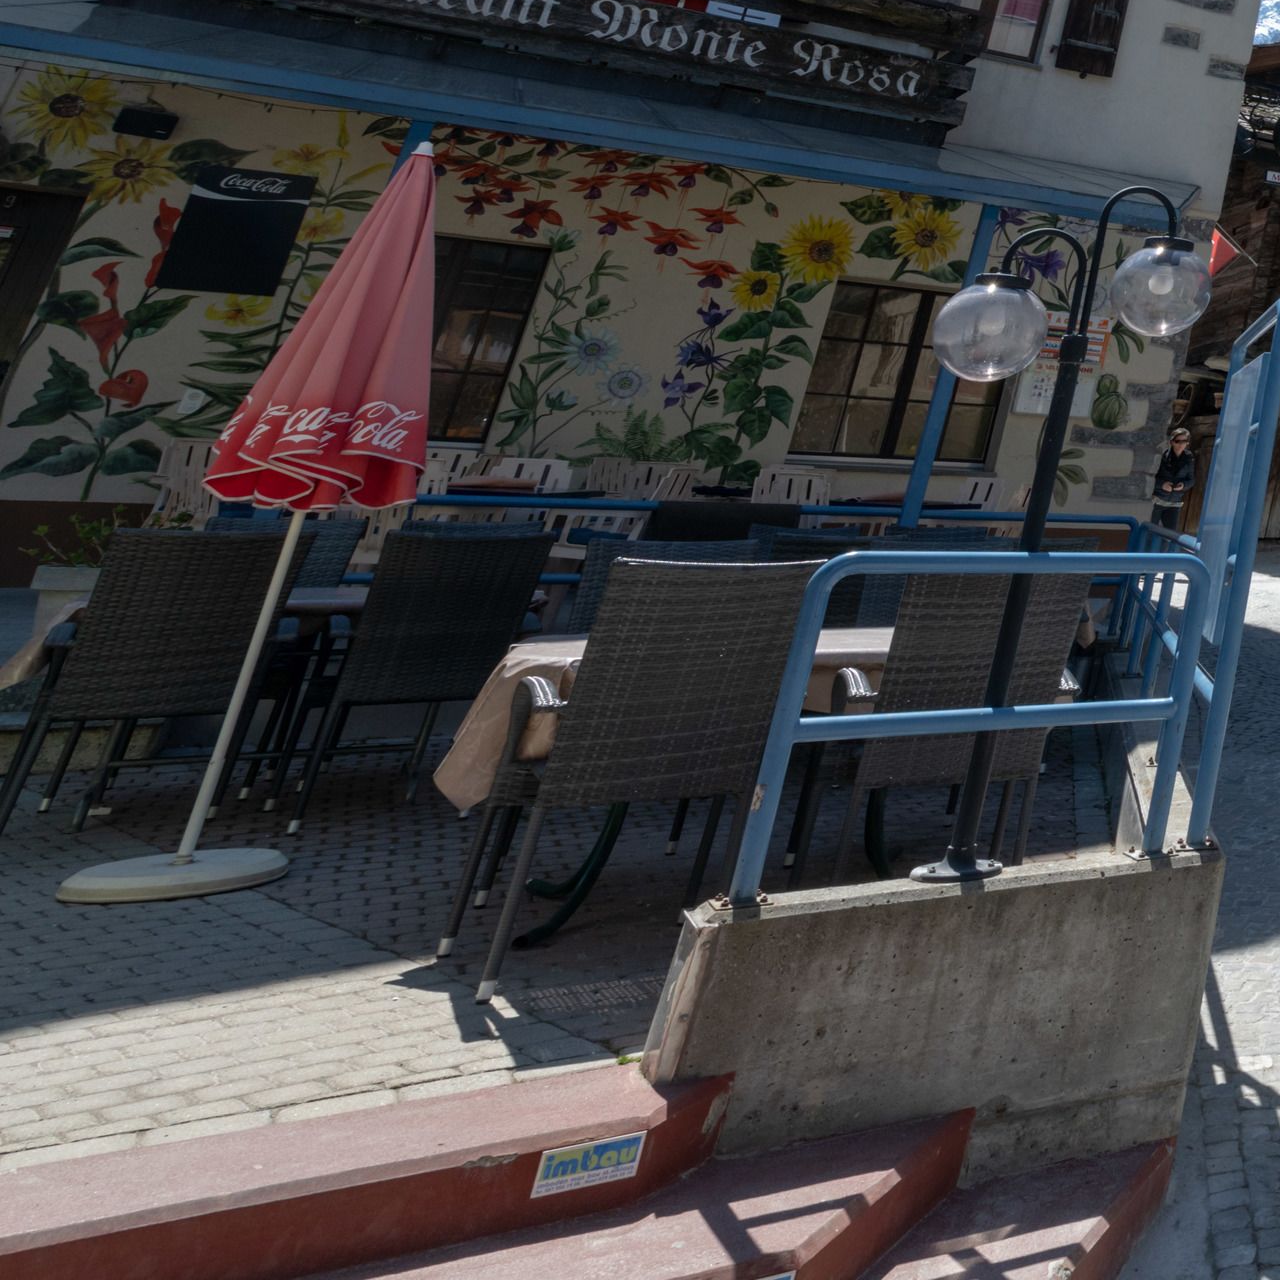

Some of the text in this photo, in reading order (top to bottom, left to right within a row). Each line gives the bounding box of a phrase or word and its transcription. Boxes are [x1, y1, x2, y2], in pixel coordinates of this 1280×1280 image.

[584, 0, 767, 67] Monte
[790, 38, 922, 97] Rosa
[543, 1145, 638, 1180] imbau
